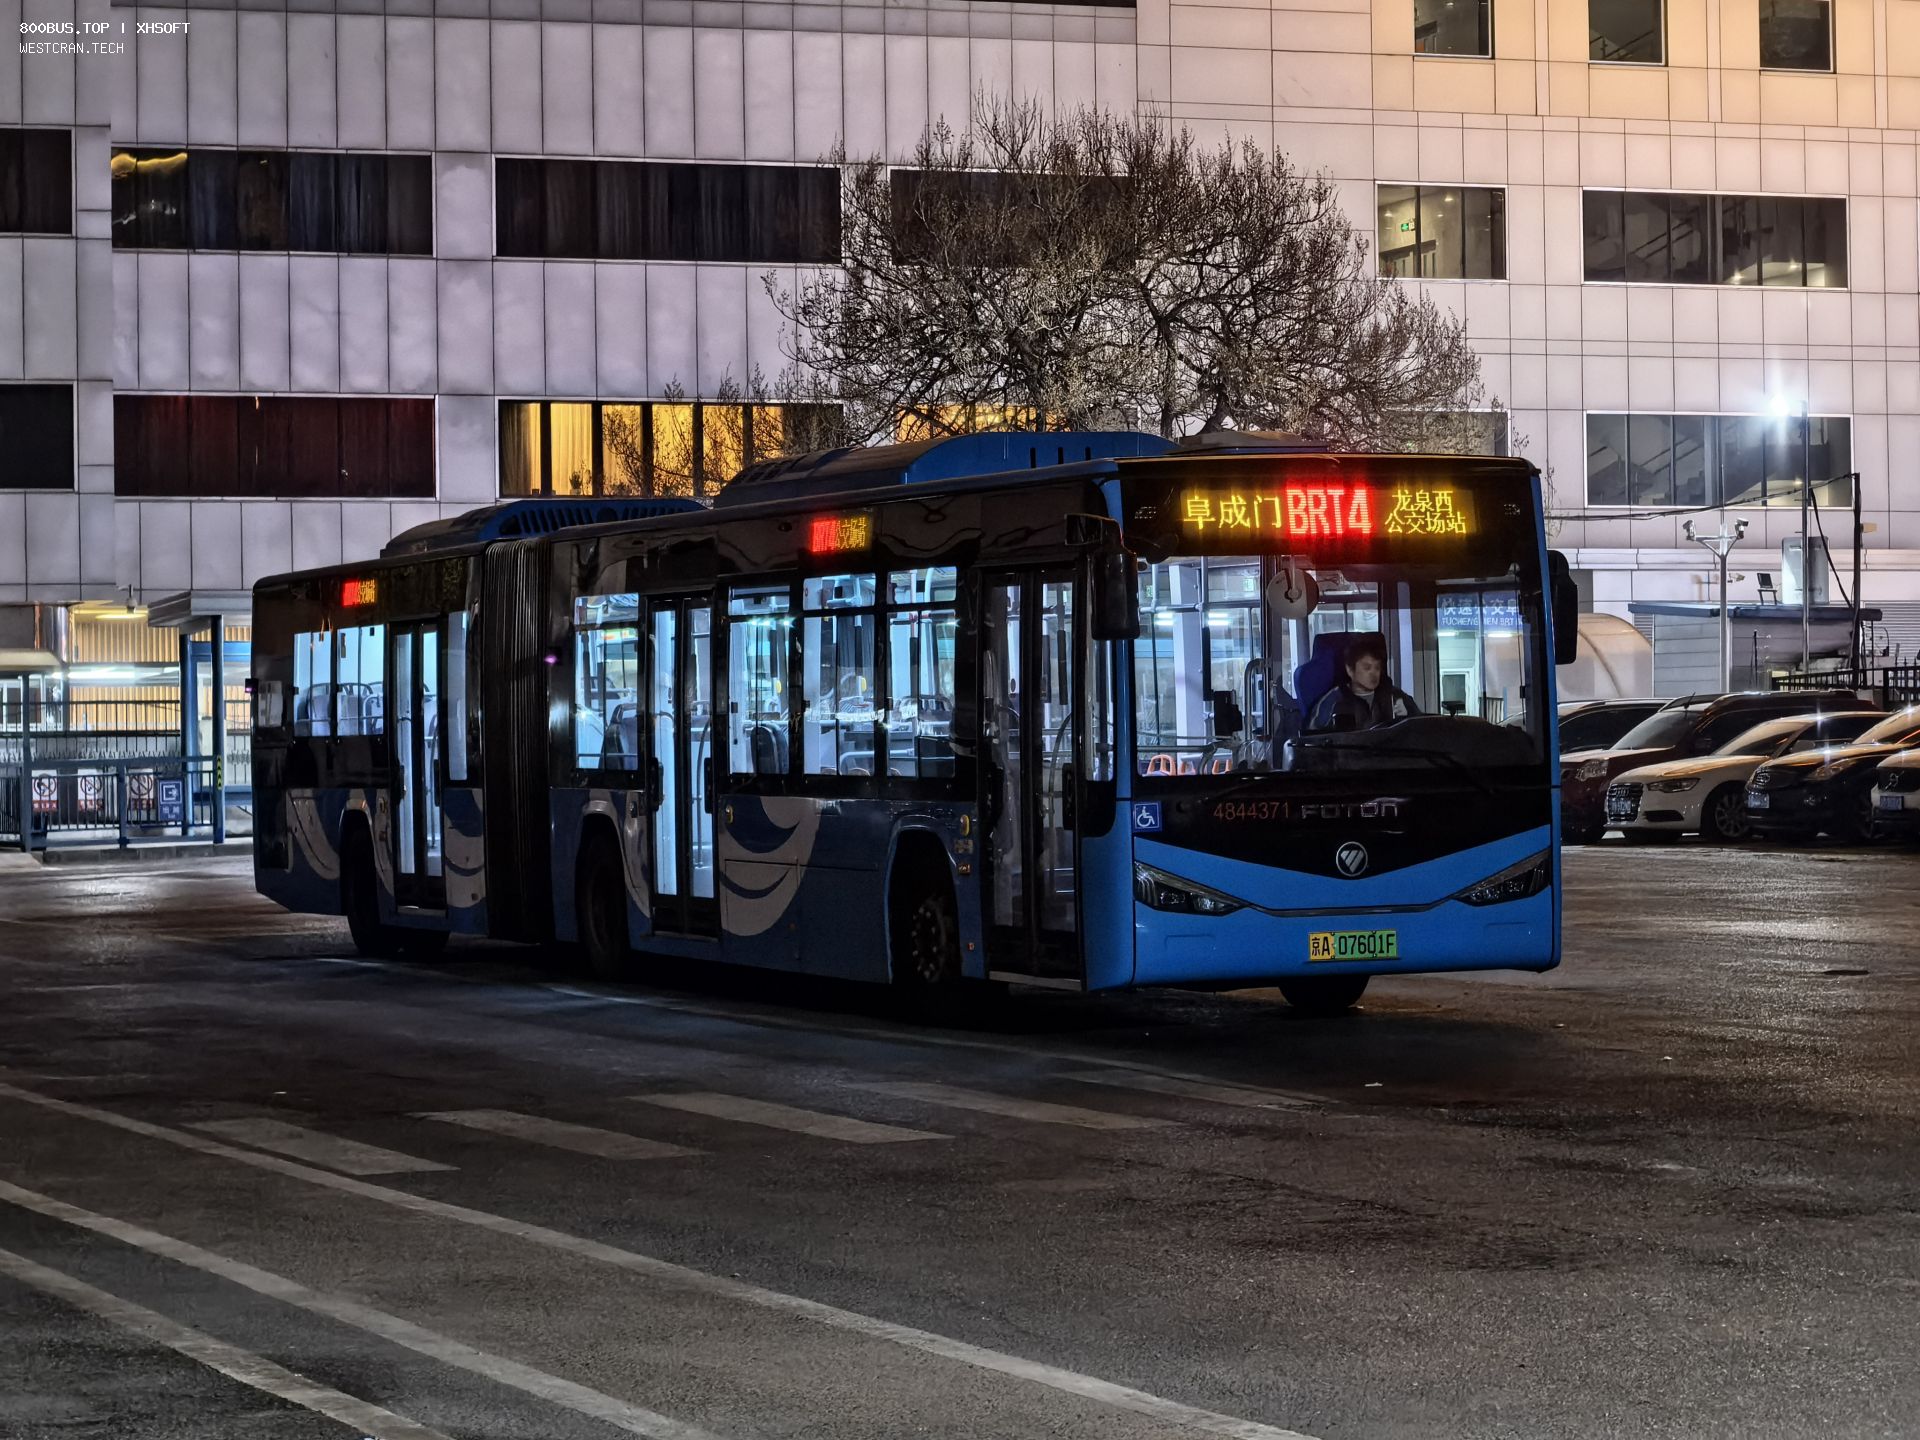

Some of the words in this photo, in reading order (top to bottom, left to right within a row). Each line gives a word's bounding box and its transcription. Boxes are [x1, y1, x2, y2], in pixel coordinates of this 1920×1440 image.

[1184, 495, 1281, 529] 阜成门
[1286, 488, 1371, 534] BRT4
[1392, 489, 1453, 512] 龙泉西
[1385, 511, 1467, 534] 公交场站
[1213, 801, 1289, 820] 4844371
